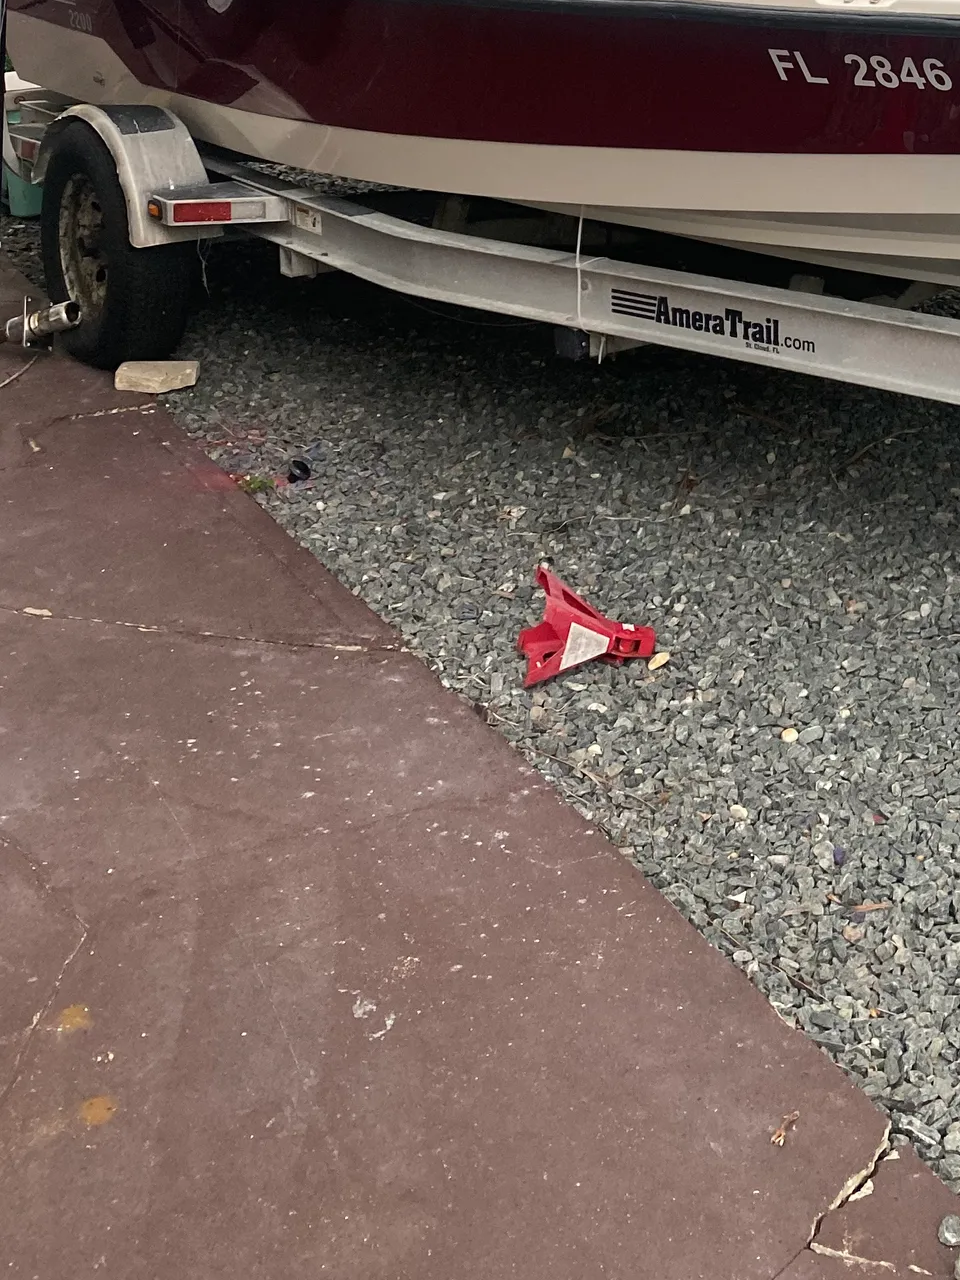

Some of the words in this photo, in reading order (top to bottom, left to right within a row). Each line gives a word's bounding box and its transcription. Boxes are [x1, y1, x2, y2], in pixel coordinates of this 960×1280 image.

[68, 9, 92, 32] 2200
[767, 48, 830, 84] FL
[844, 53, 953, 91] 2846
